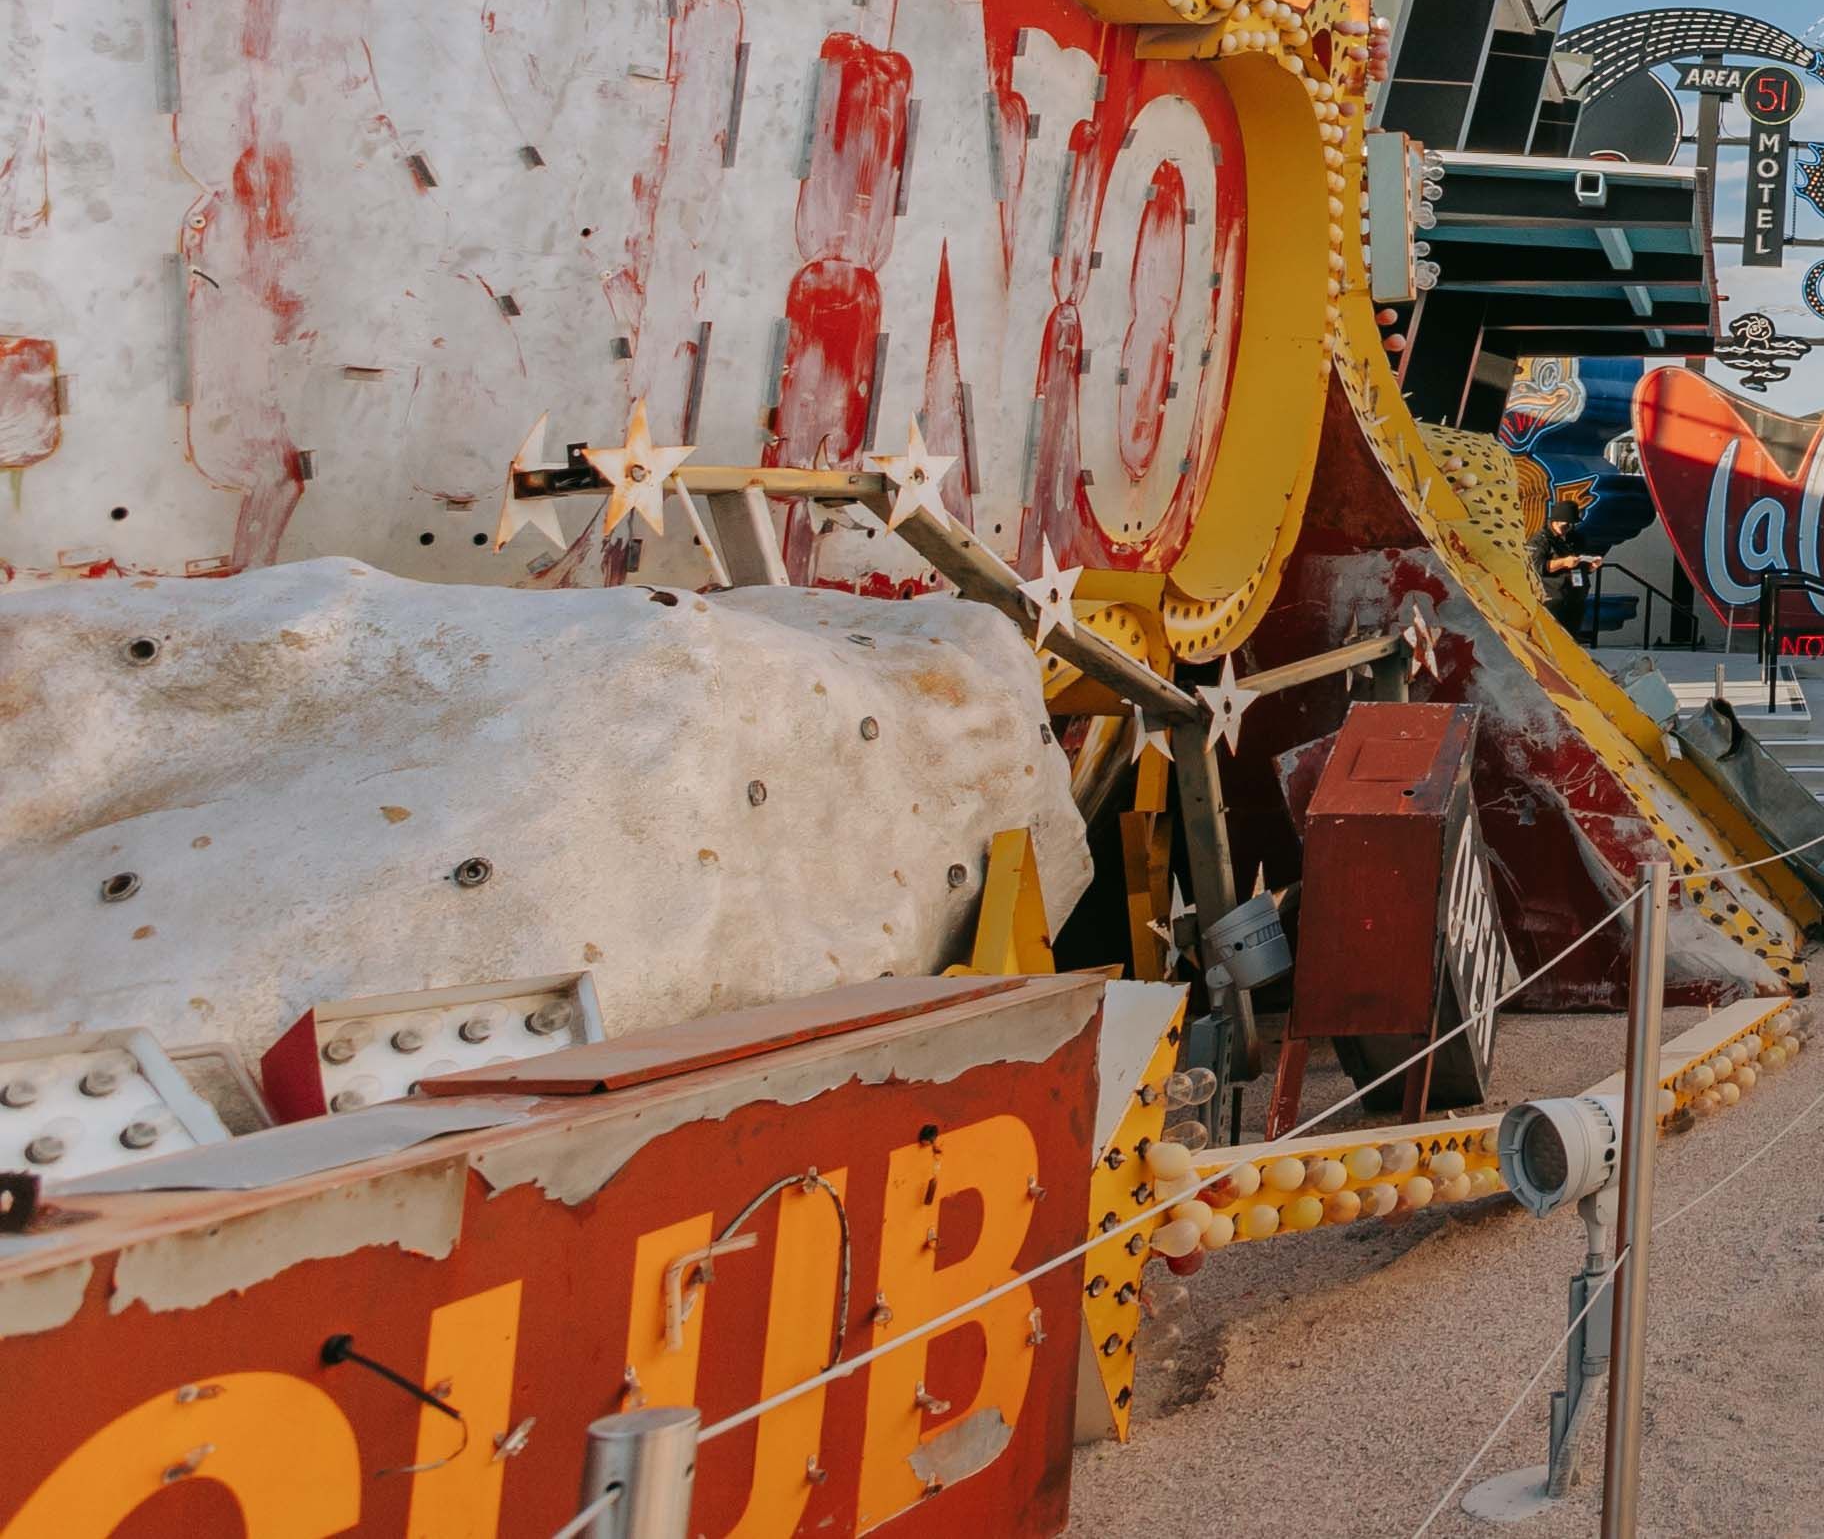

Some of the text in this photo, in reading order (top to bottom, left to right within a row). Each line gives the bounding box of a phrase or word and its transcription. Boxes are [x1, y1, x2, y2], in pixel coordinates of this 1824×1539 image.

[1684, 68, 1788, 112] AREA 51
[1755, 132, 1780, 254] MOTEL
[1704, 436, 1789, 606] La
